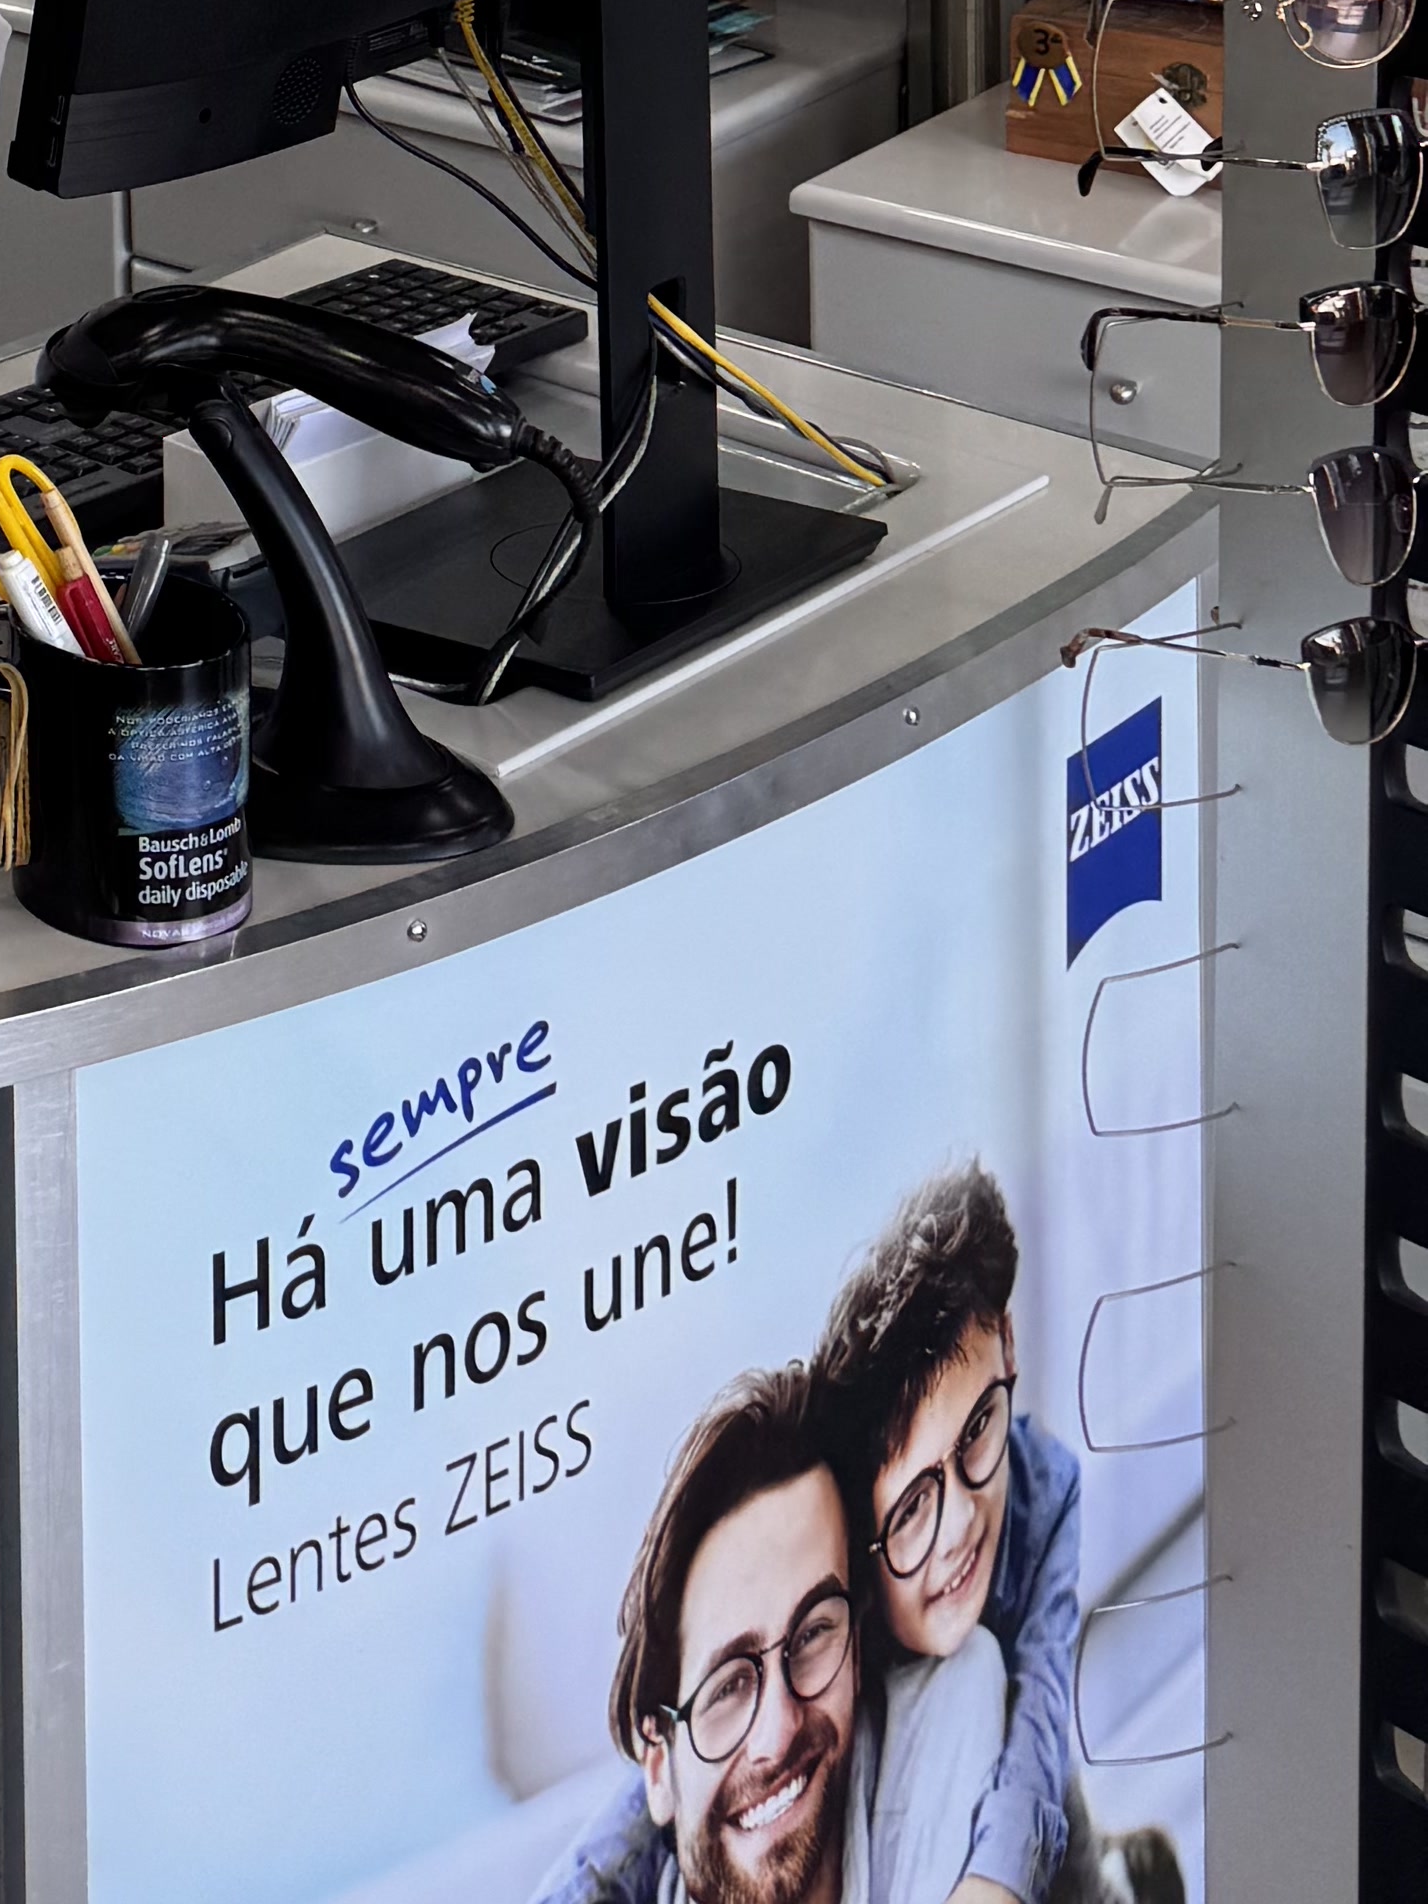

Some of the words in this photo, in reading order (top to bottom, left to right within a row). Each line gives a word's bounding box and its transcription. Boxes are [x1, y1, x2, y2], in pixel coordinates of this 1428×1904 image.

[138, 850, 224, 881] SofLens
[138, 885, 181, 908] daily
[185, 861, 249, 902] disposable
[1070, 756, 1159, 863] ZEISS
[209, 1213, 328, 1346] Há
[367, 1152, 544, 1290] uma
[574, 1037, 792, 1198] visão
[330, 1017, 552, 1192] sempre
[206, 1361, 373, 1507] que
[411, 1288, 549, 1411] nos
[581, 1180, 742, 1336] une!
[209, 1491, 418, 1633] Lentes
[444, 1397, 596, 1537] ZEISS
